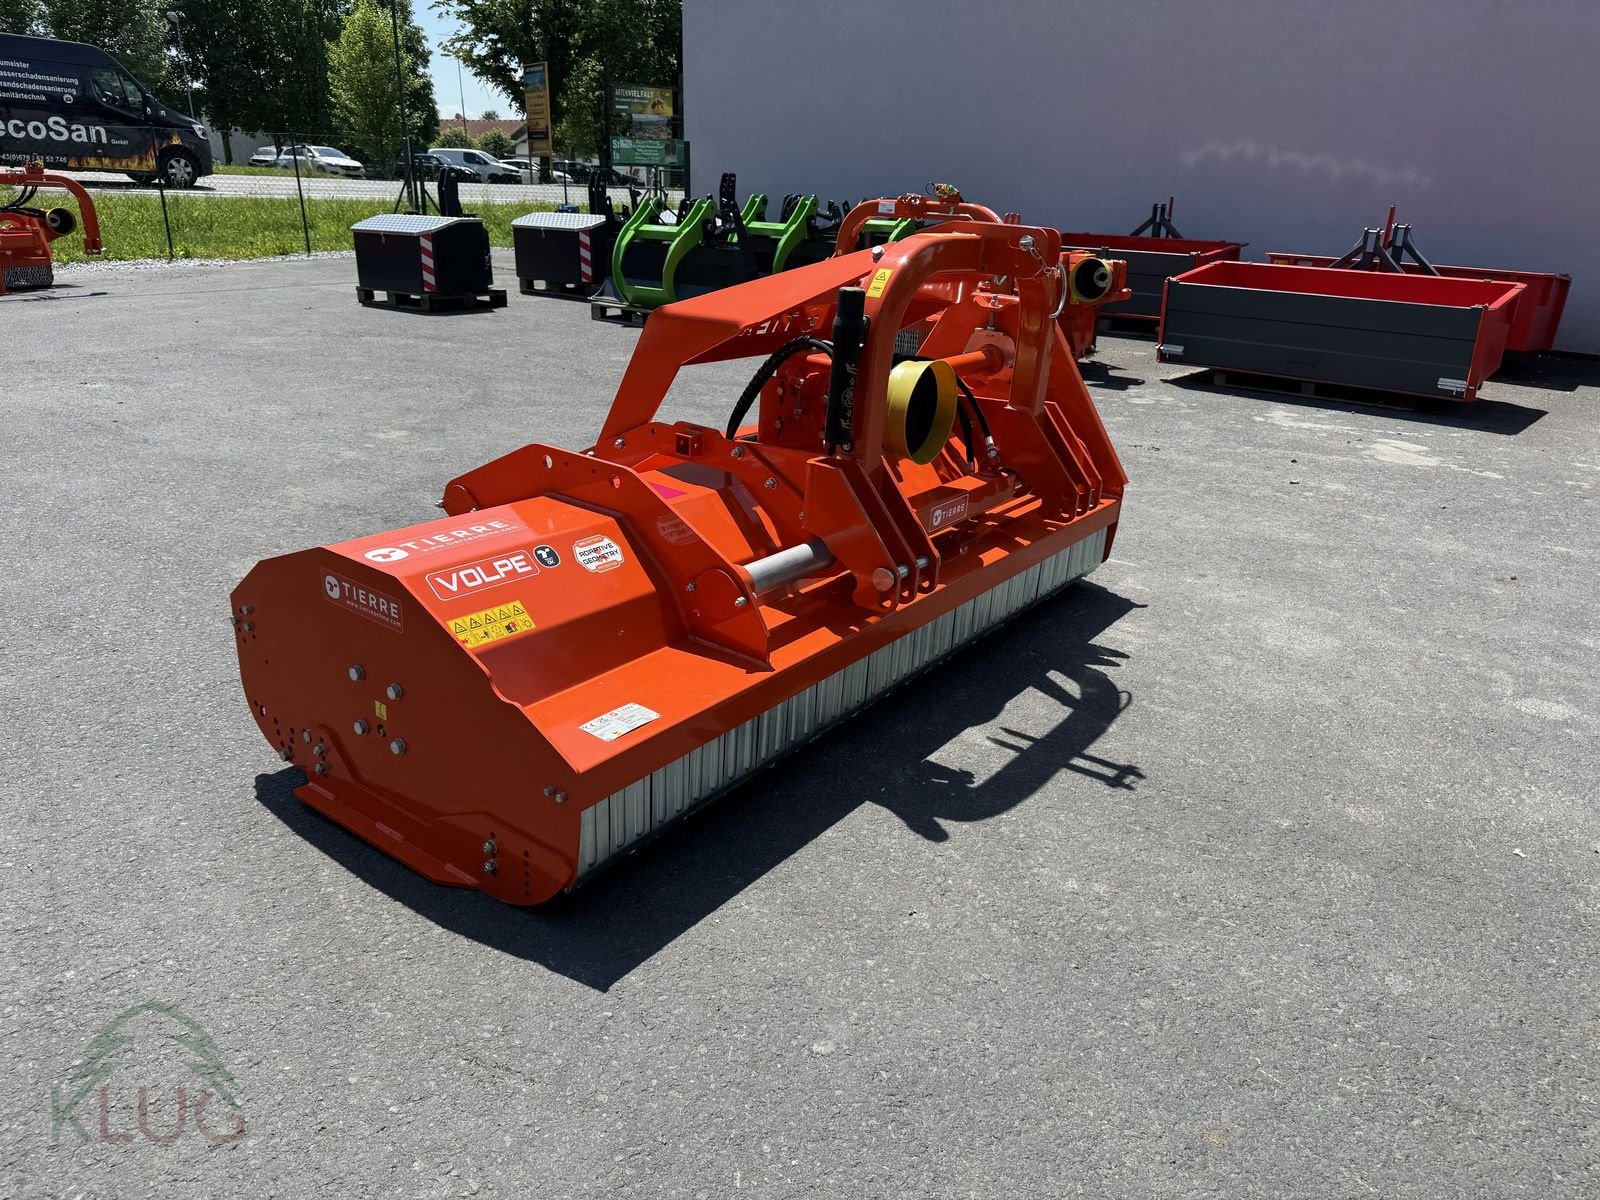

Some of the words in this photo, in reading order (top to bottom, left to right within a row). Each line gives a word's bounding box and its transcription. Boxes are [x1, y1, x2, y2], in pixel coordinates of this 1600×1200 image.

[942, 503, 965, 519] TIERRE
[399, 520, 509, 550] TIERRE
[435, 554, 533, 592] VOLPE
[341, 581, 399, 619] TIERRE
